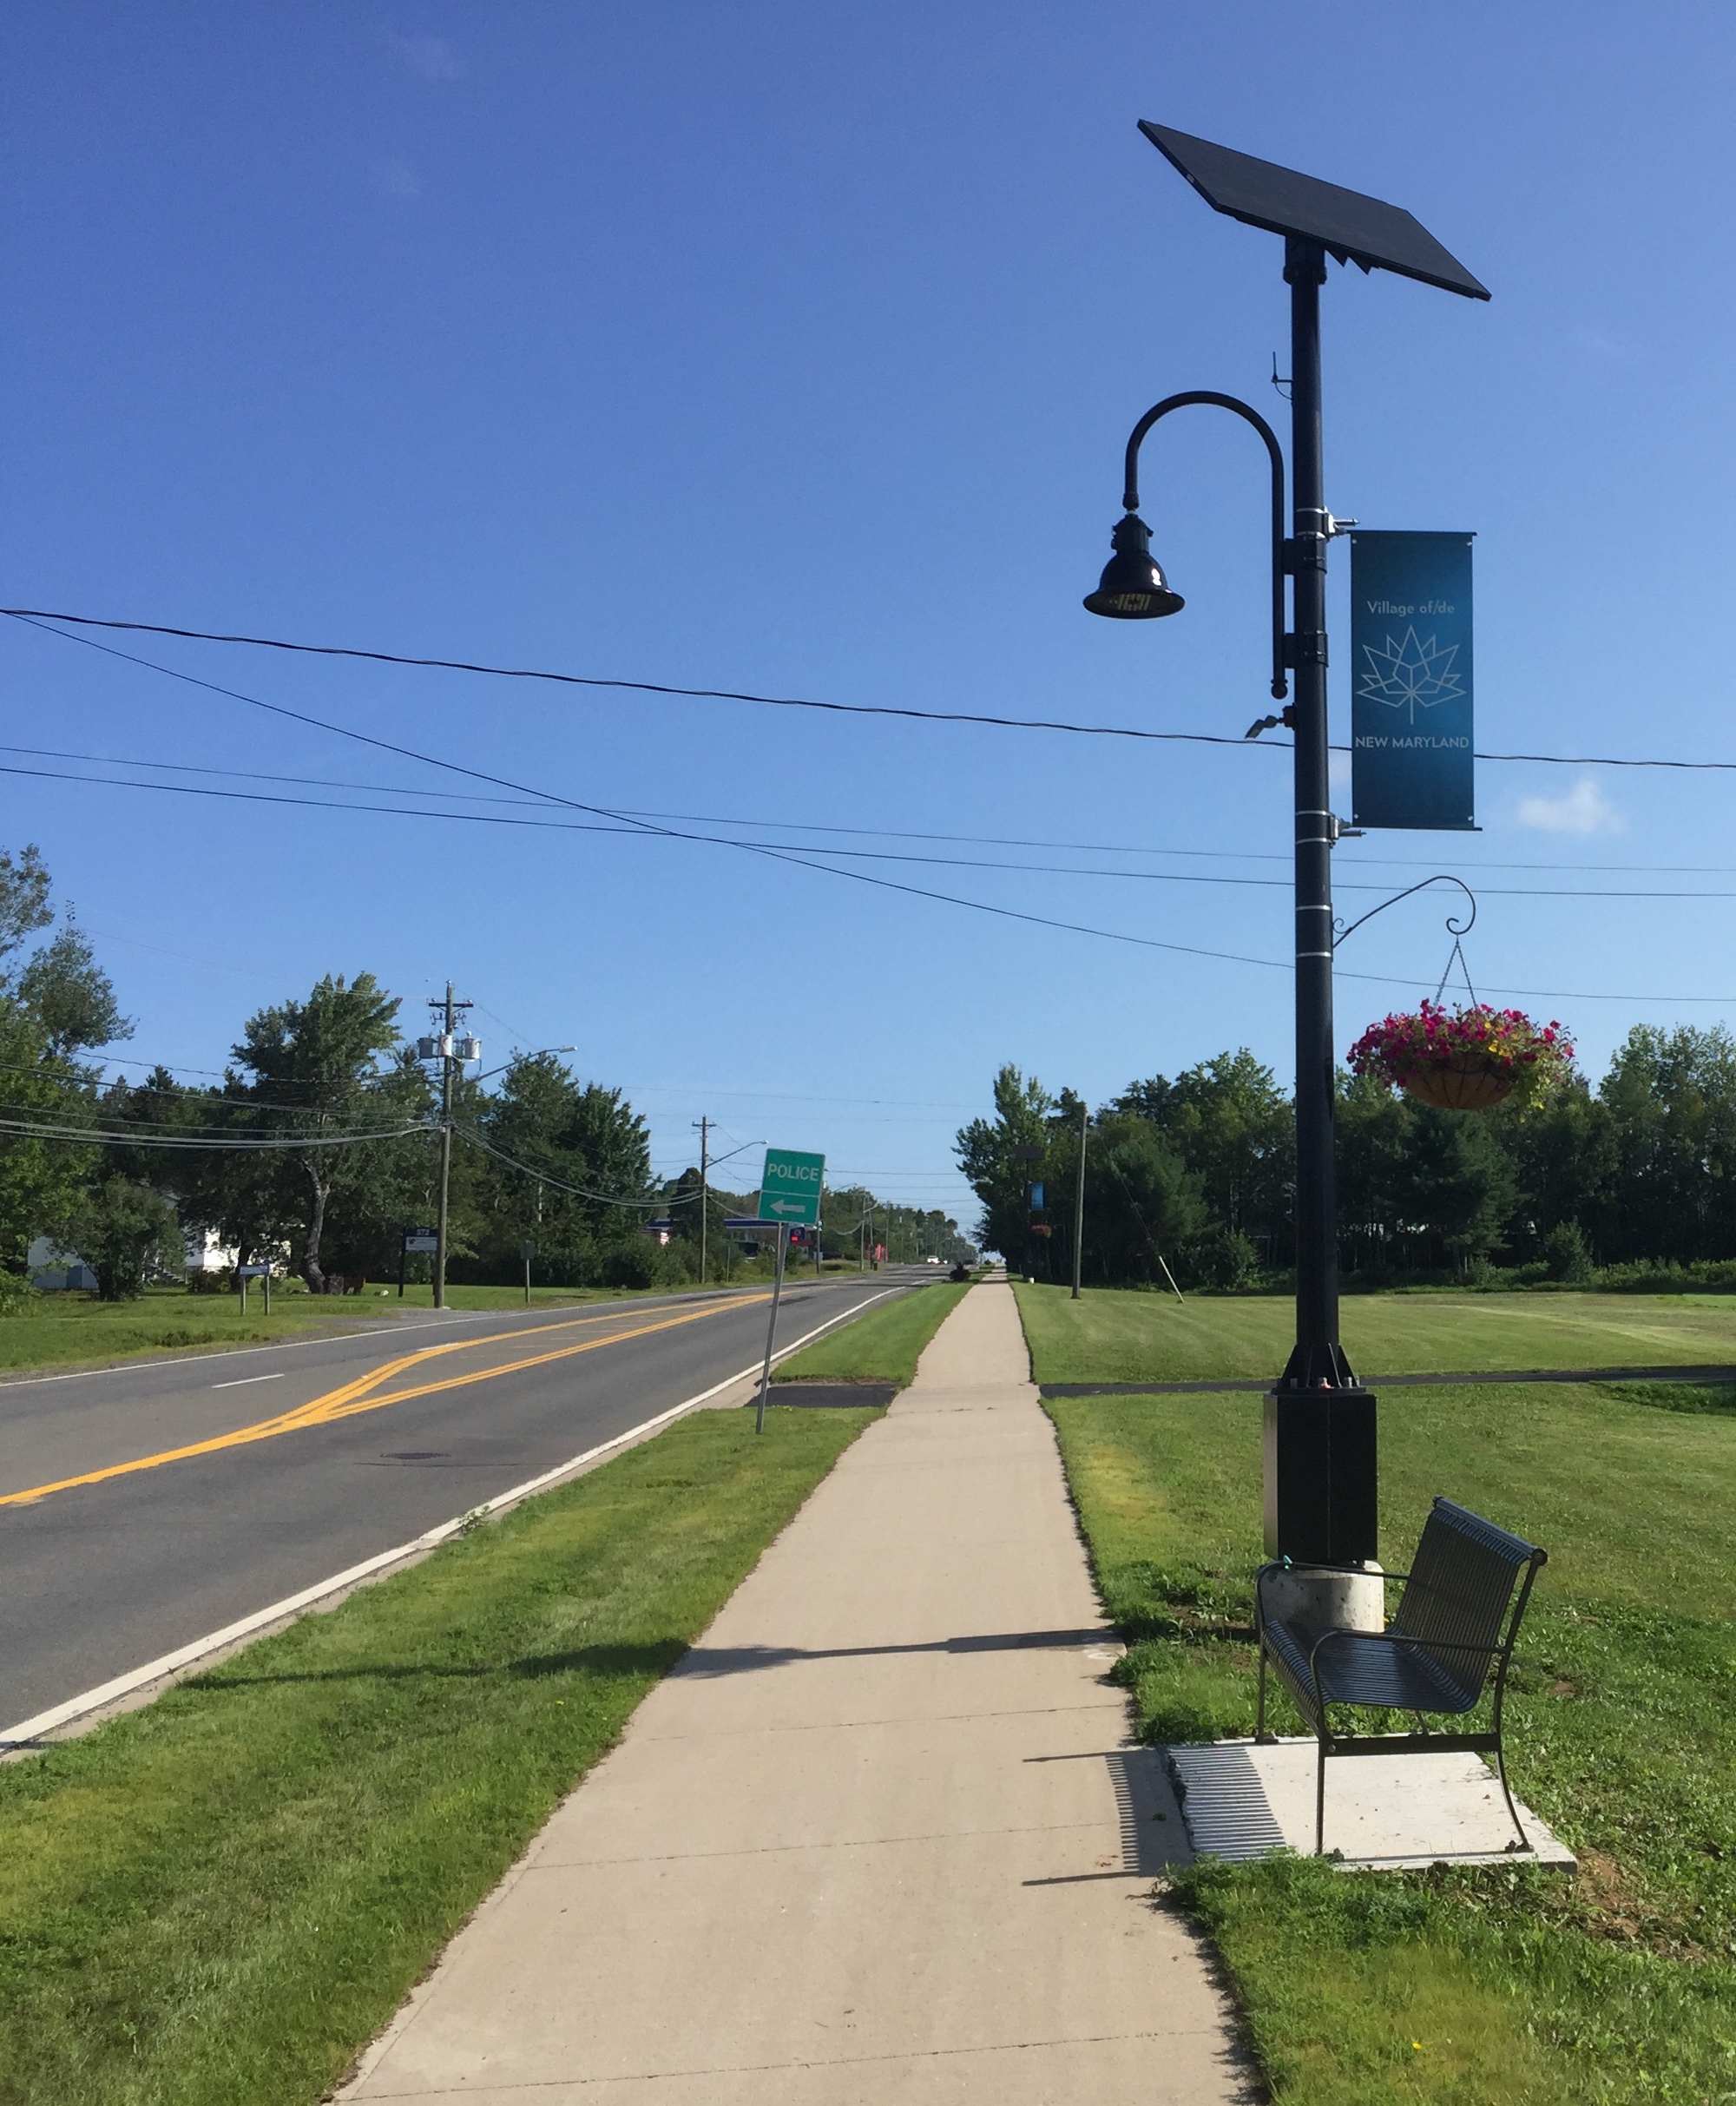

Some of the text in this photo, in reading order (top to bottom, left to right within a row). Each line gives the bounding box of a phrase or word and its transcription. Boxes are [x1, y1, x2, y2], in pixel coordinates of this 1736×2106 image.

[1367, 600, 1456, 617] Village of/de
[1355, 737, 1470, 748] NEW MARYLAND
[767, 1163, 819, 1181] POLICE
